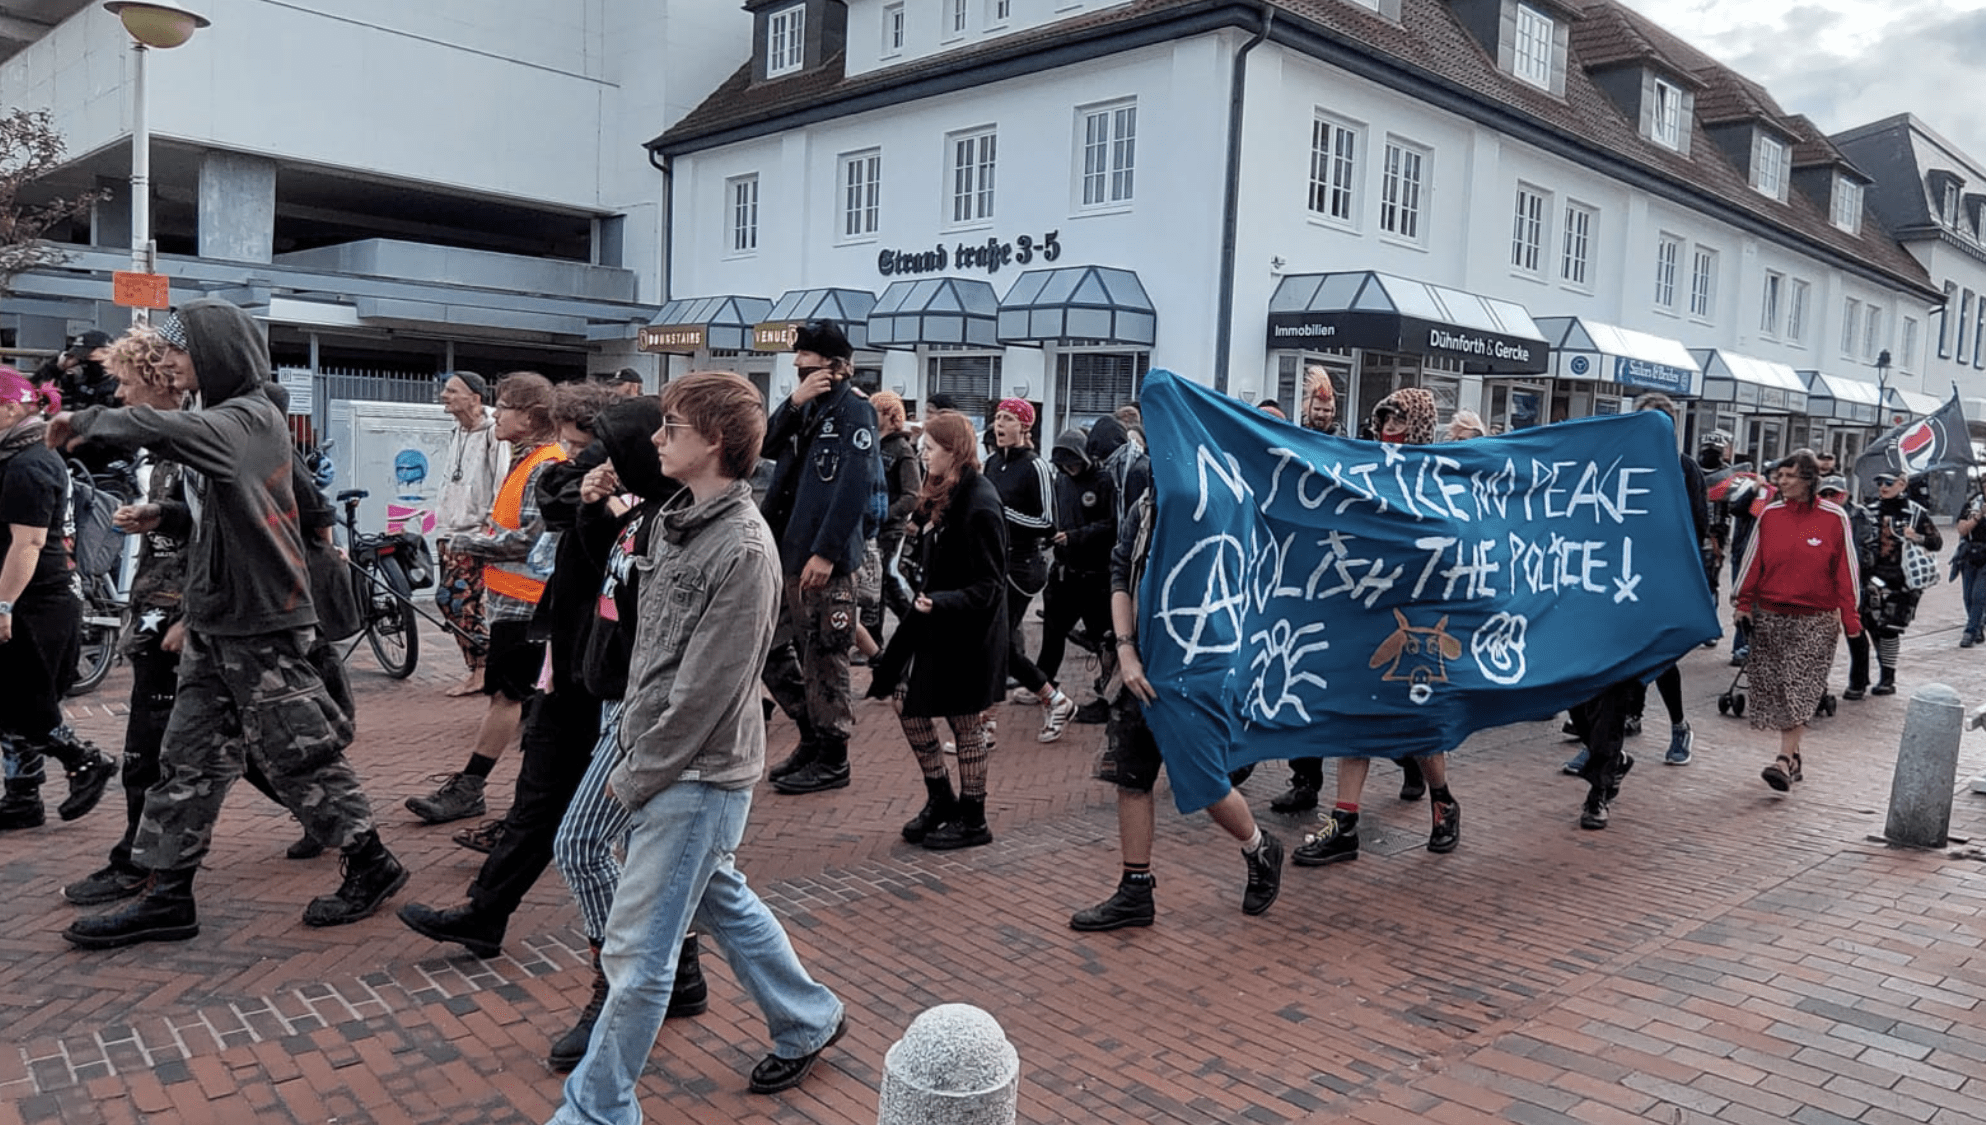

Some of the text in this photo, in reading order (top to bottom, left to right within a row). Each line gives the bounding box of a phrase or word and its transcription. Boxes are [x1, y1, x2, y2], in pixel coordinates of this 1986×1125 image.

[878, 243, 948, 276] Strand
[1015, 229, 1061, 265] 3-5
[755, 329, 787, 343] VENUE
[1275, 324, 1335, 337] Immobilien
[1430, 329, 1529, 362] Dühnforth & Gercke
[1193, 444, 1255, 522] N
[1470, 457, 1516, 521] NO
[1523, 454, 1658, 524] PEACE
[1154, 526, 1405, 665] AOLISH
[1411, 536, 1500, 601] THE
